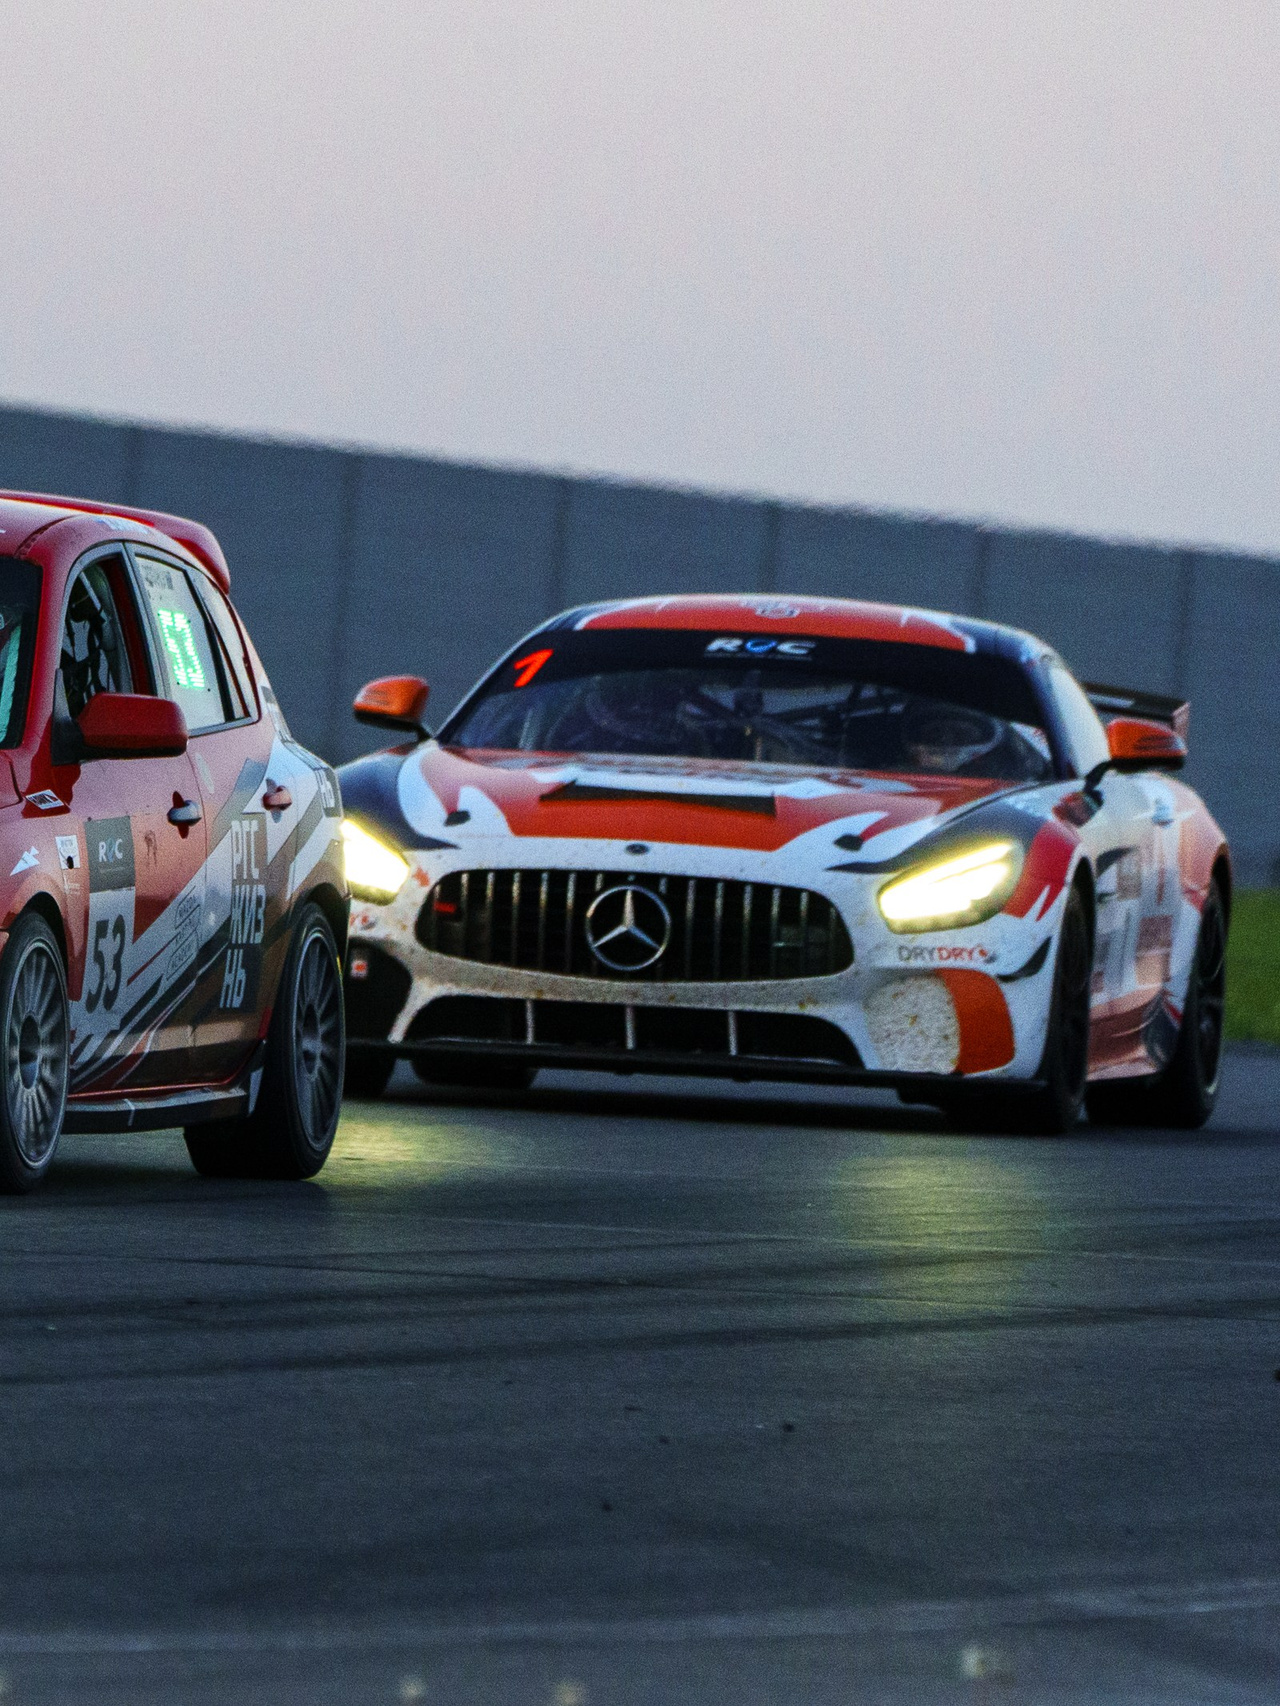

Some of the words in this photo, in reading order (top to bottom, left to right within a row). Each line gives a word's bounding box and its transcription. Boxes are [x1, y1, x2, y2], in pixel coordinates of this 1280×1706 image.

[513, 649, 554, 688] 1
[229, 884, 267, 944] ЖИЗ
[86, 914, 126, 1013] 53
[219, 949, 246, 1008] НЬ
